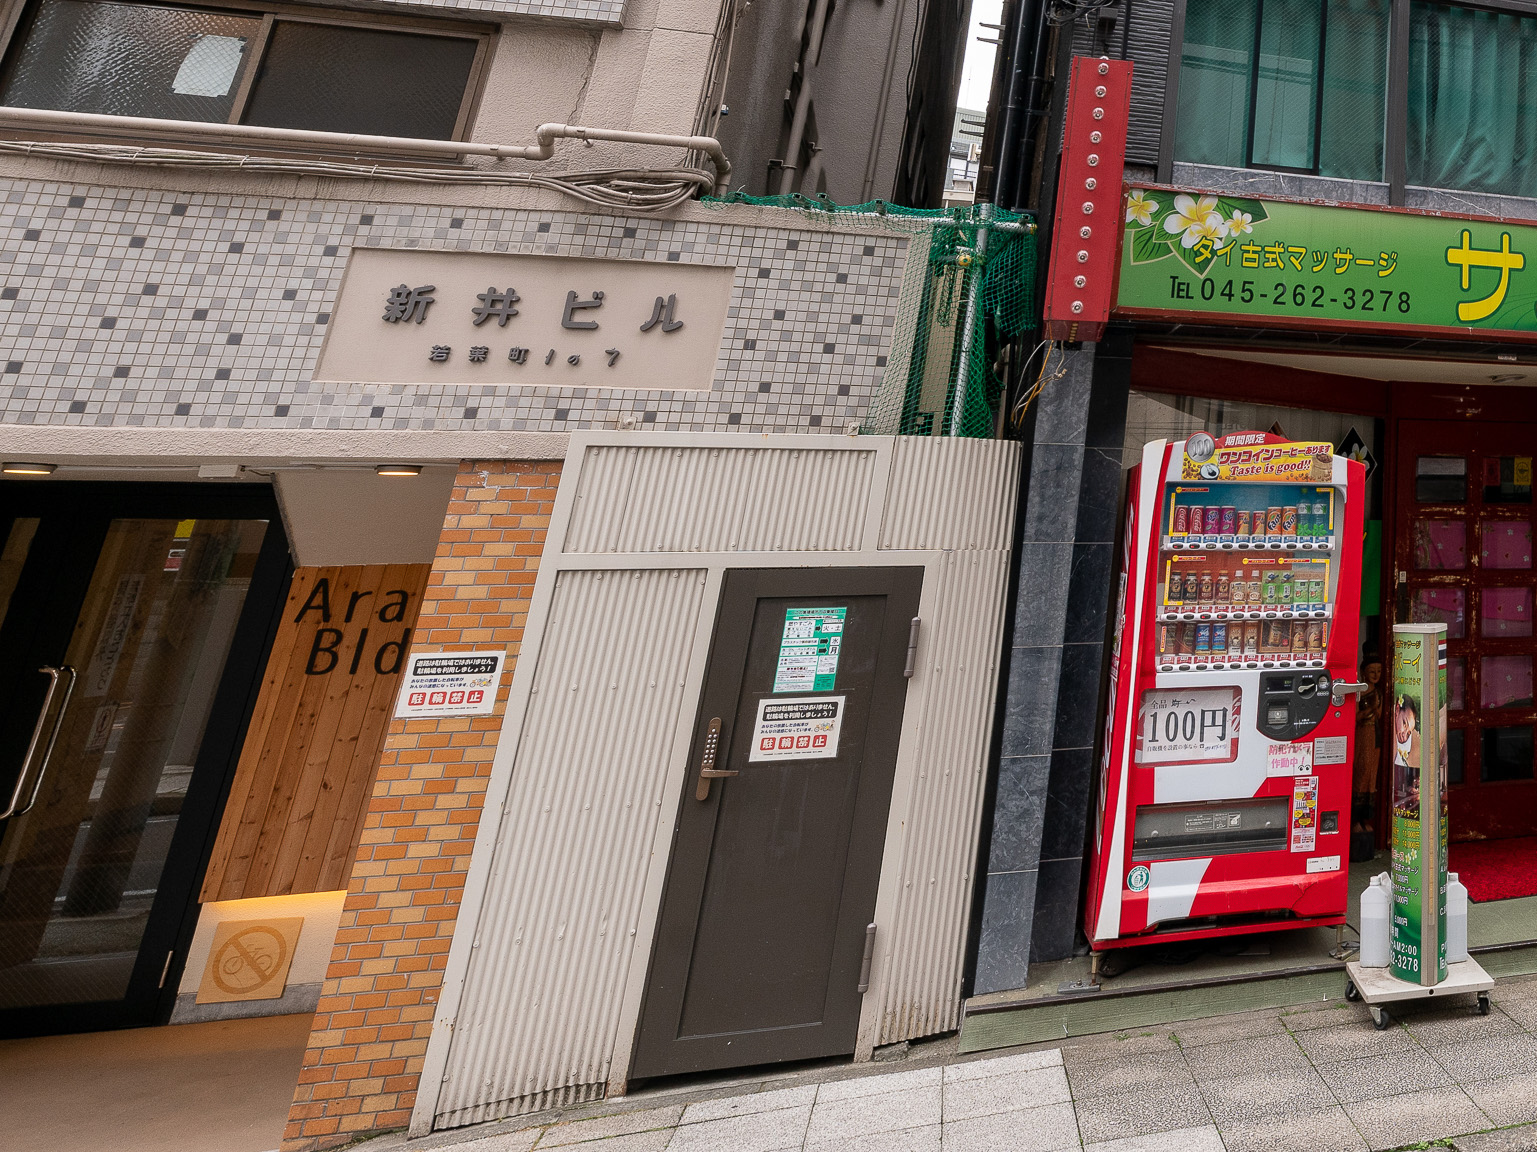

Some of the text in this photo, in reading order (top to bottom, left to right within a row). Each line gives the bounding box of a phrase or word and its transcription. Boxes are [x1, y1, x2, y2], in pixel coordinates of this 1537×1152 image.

[1193, 235, 1399, 279] タイ古式マッサージ
[382, 284, 685, 333] 新井ビル
[1200, 277, 1411, 314] 045-262-3278
[1224, 433, 1266, 447] 期間限定
[1230, 459, 1312, 477] Taste is good!!
[1148, 707, 1229, 743] 100円
